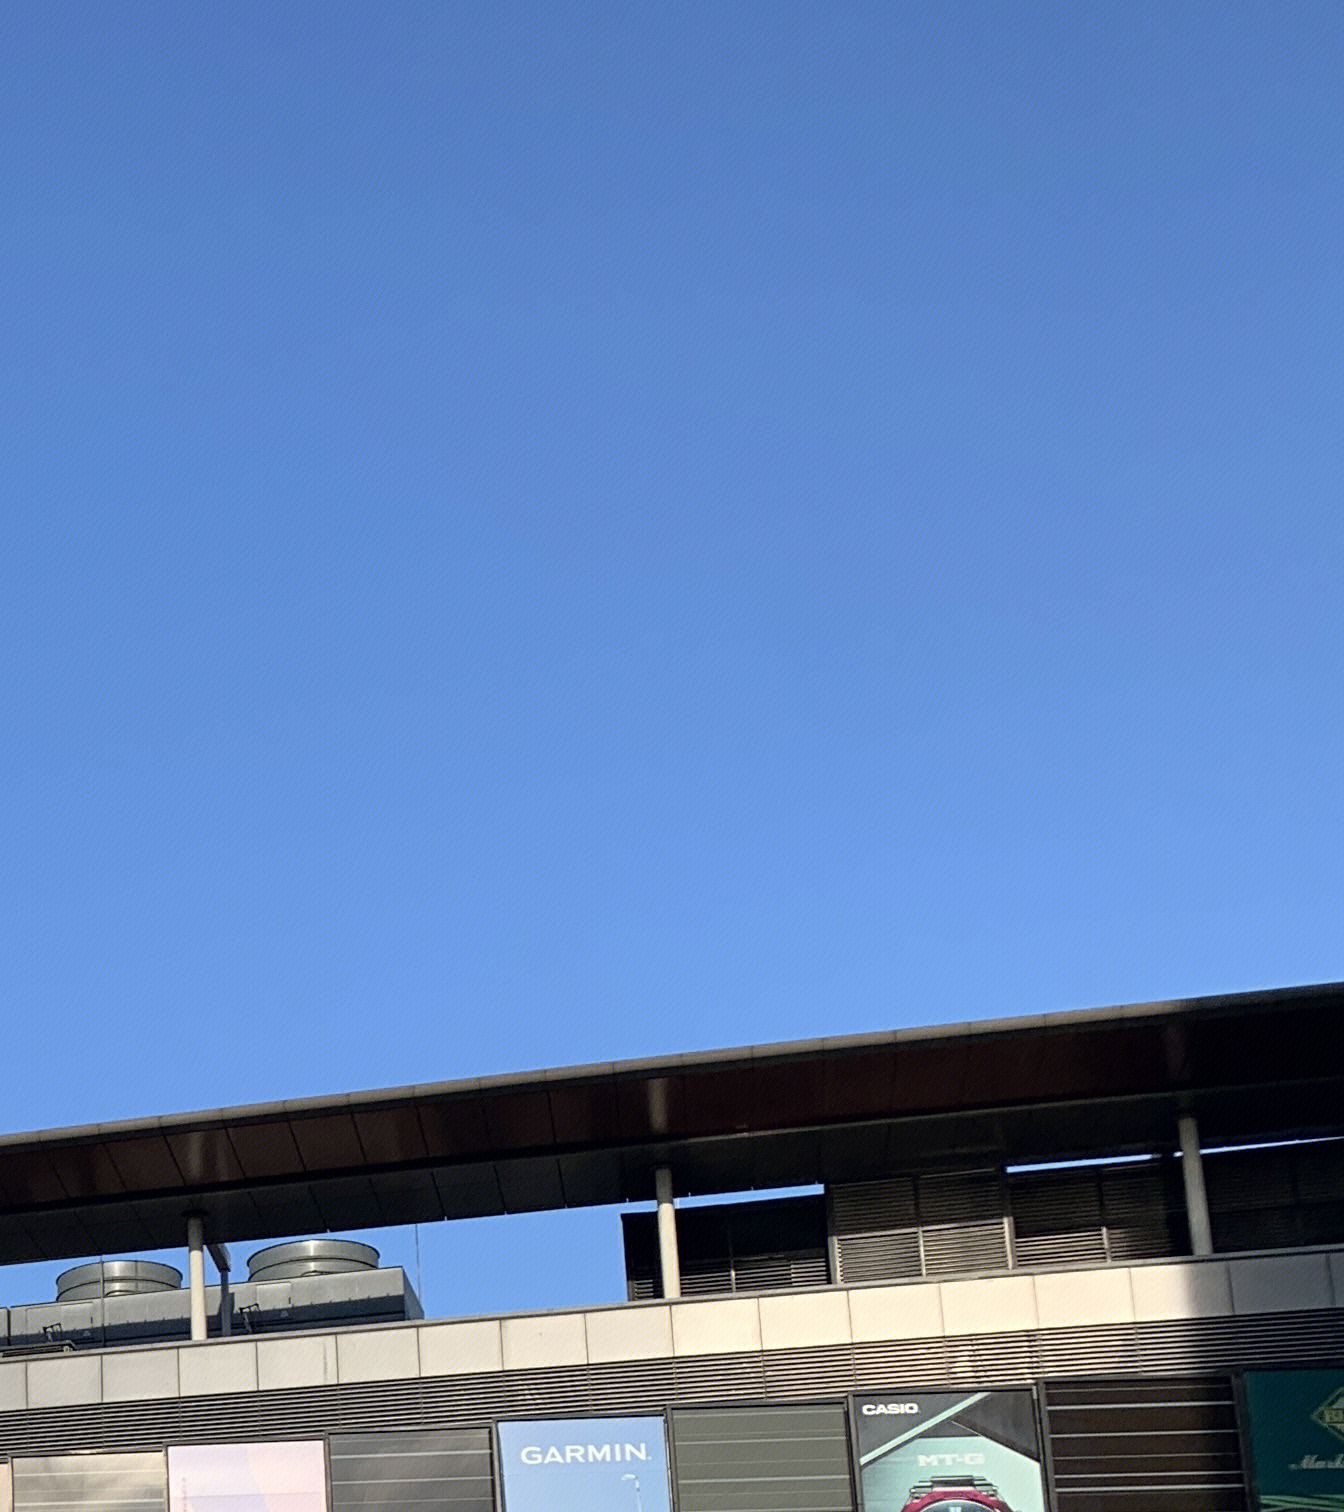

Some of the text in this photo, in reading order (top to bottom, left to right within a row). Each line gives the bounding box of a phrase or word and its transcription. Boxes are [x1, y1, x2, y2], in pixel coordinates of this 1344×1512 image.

[862, 1403, 919, 1415] CASIO
[520, 1443, 648, 1464] GARMIN
[918, 1453, 985, 1466] MT-G
